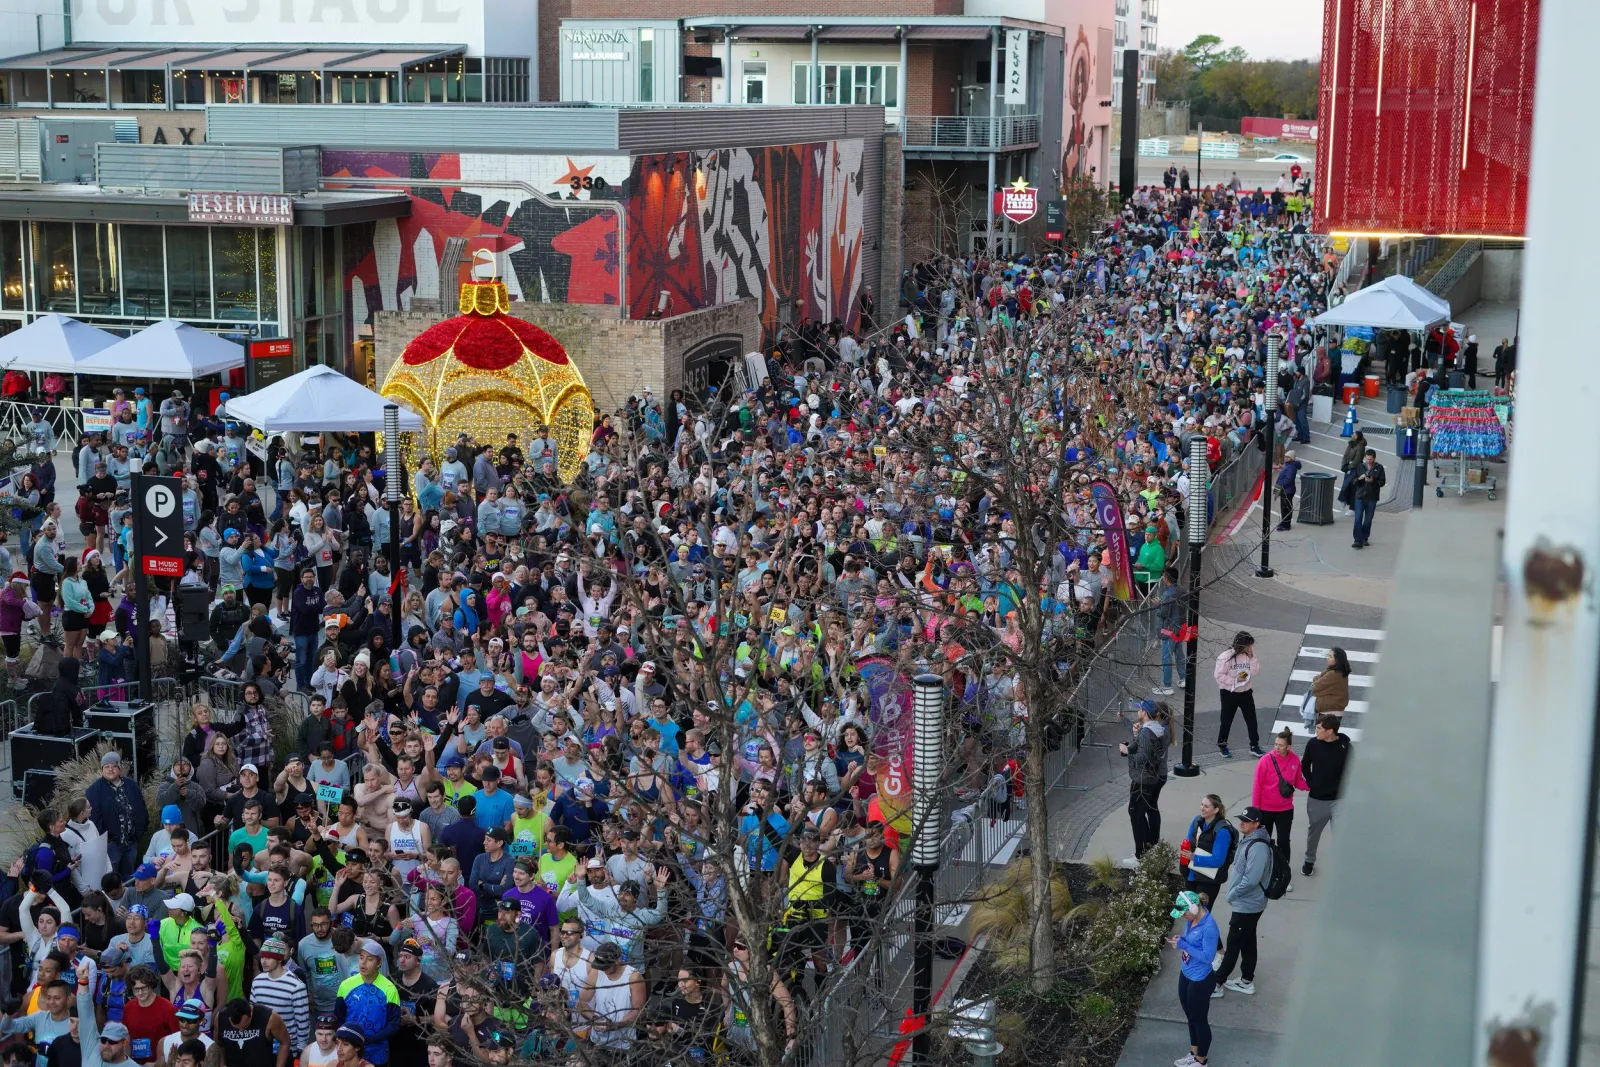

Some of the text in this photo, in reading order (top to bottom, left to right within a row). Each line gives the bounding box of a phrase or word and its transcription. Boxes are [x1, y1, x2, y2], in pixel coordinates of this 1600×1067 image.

[564, 29, 629, 51] NIRVANA
[573, 52, 625, 60] BAR LOUNGE
[1012, 33, 1021, 94] NIRVANA
[570, 176, 604, 190] 330
[190, 194, 290, 215] RESERVOIR
[1006, 194, 1033, 202] MAMA
[1006, 201, 1033, 209] TRIED
[155, 492, 168, 512] P
[158, 560, 178, 568] MUSIC
[879, 693, 902, 724] B
[883, 728, 906, 796] Group
[320, 788, 336, 798] 3:10
[512, 845, 527, 853] 3:20
